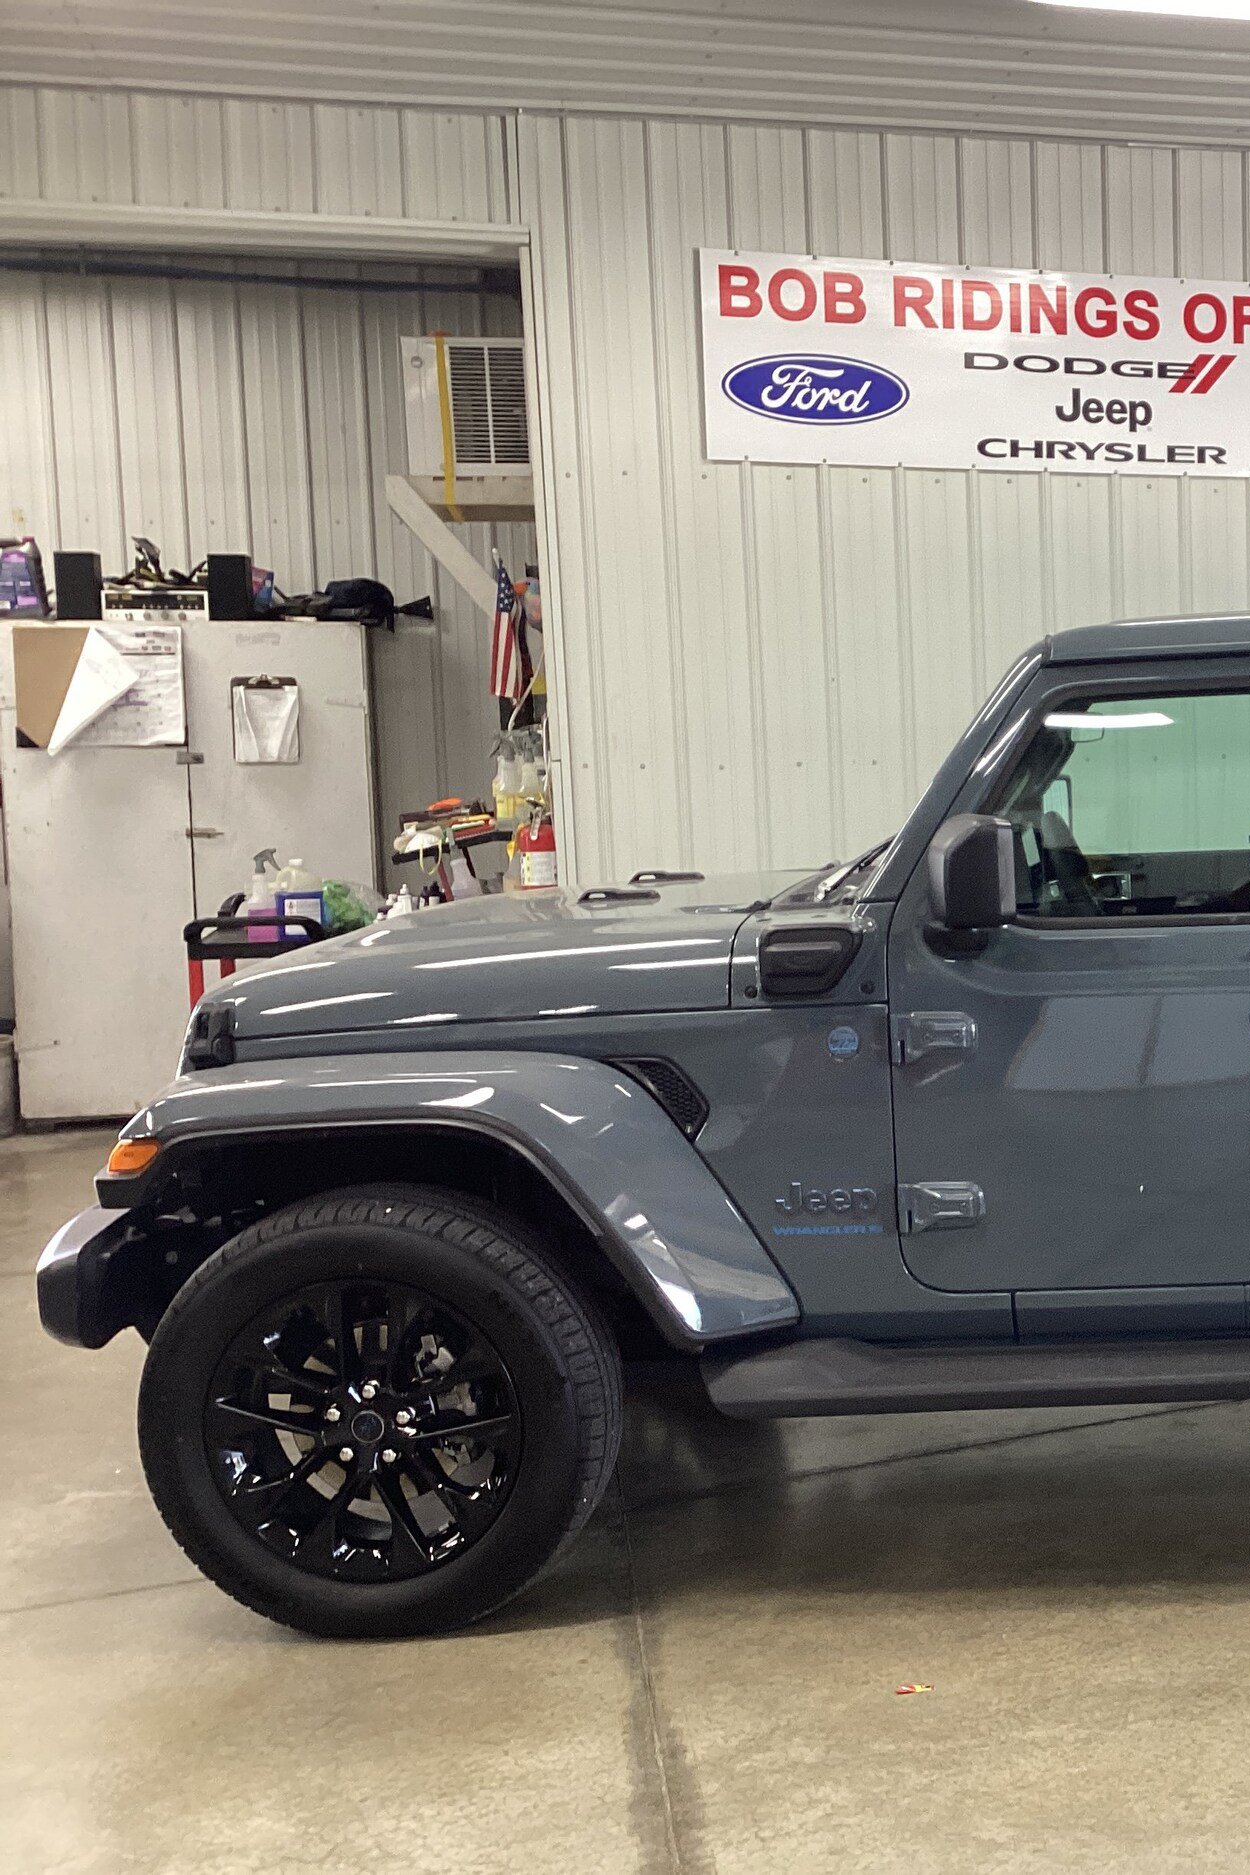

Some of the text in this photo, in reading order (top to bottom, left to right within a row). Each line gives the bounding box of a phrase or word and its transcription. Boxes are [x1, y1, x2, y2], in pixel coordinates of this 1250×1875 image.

[717, 264, 867, 324] BOB
[893, 276, 1160, 341] RIDINGS
[964, 352, 1197, 381] DODGE
[761, 364, 872, 413] Ford
[1055, 387, 1153, 432] Jeep
[976, 438, 1227, 465] CHRYSLER
[775, 1182, 879, 1218] Jeep
